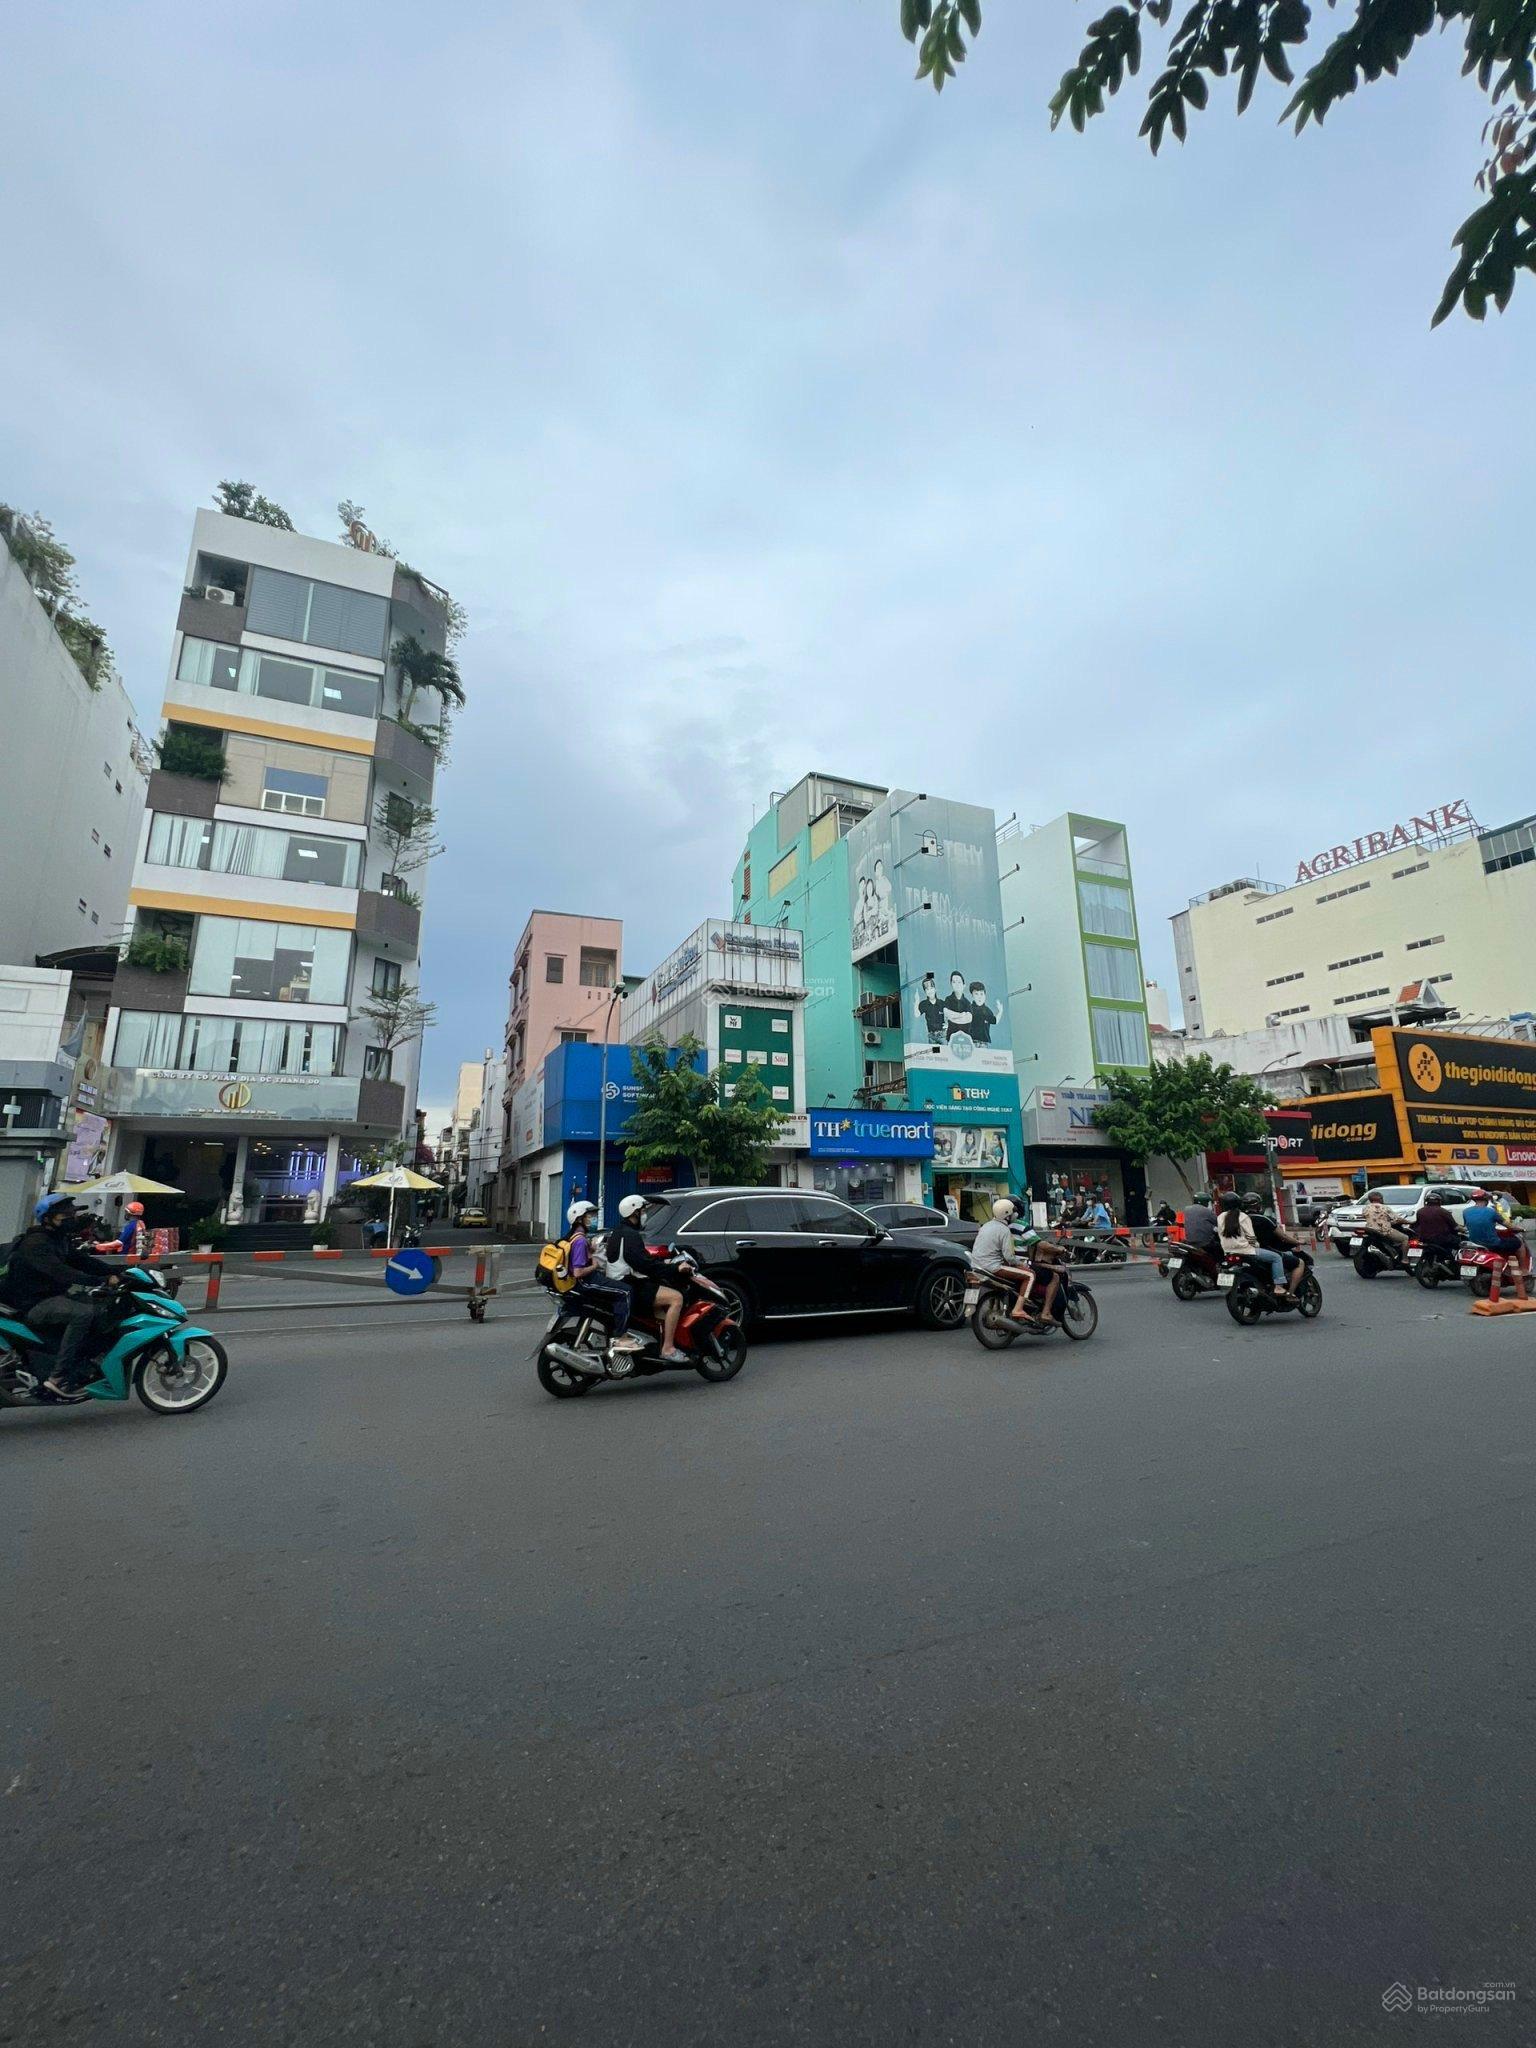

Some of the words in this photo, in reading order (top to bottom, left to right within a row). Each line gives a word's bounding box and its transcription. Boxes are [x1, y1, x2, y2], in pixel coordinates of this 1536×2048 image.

[1295, 799, 1472, 883] AGRIBANK
[814, 1121, 841, 1138] TH
[852, 1119, 931, 1139] truemart
